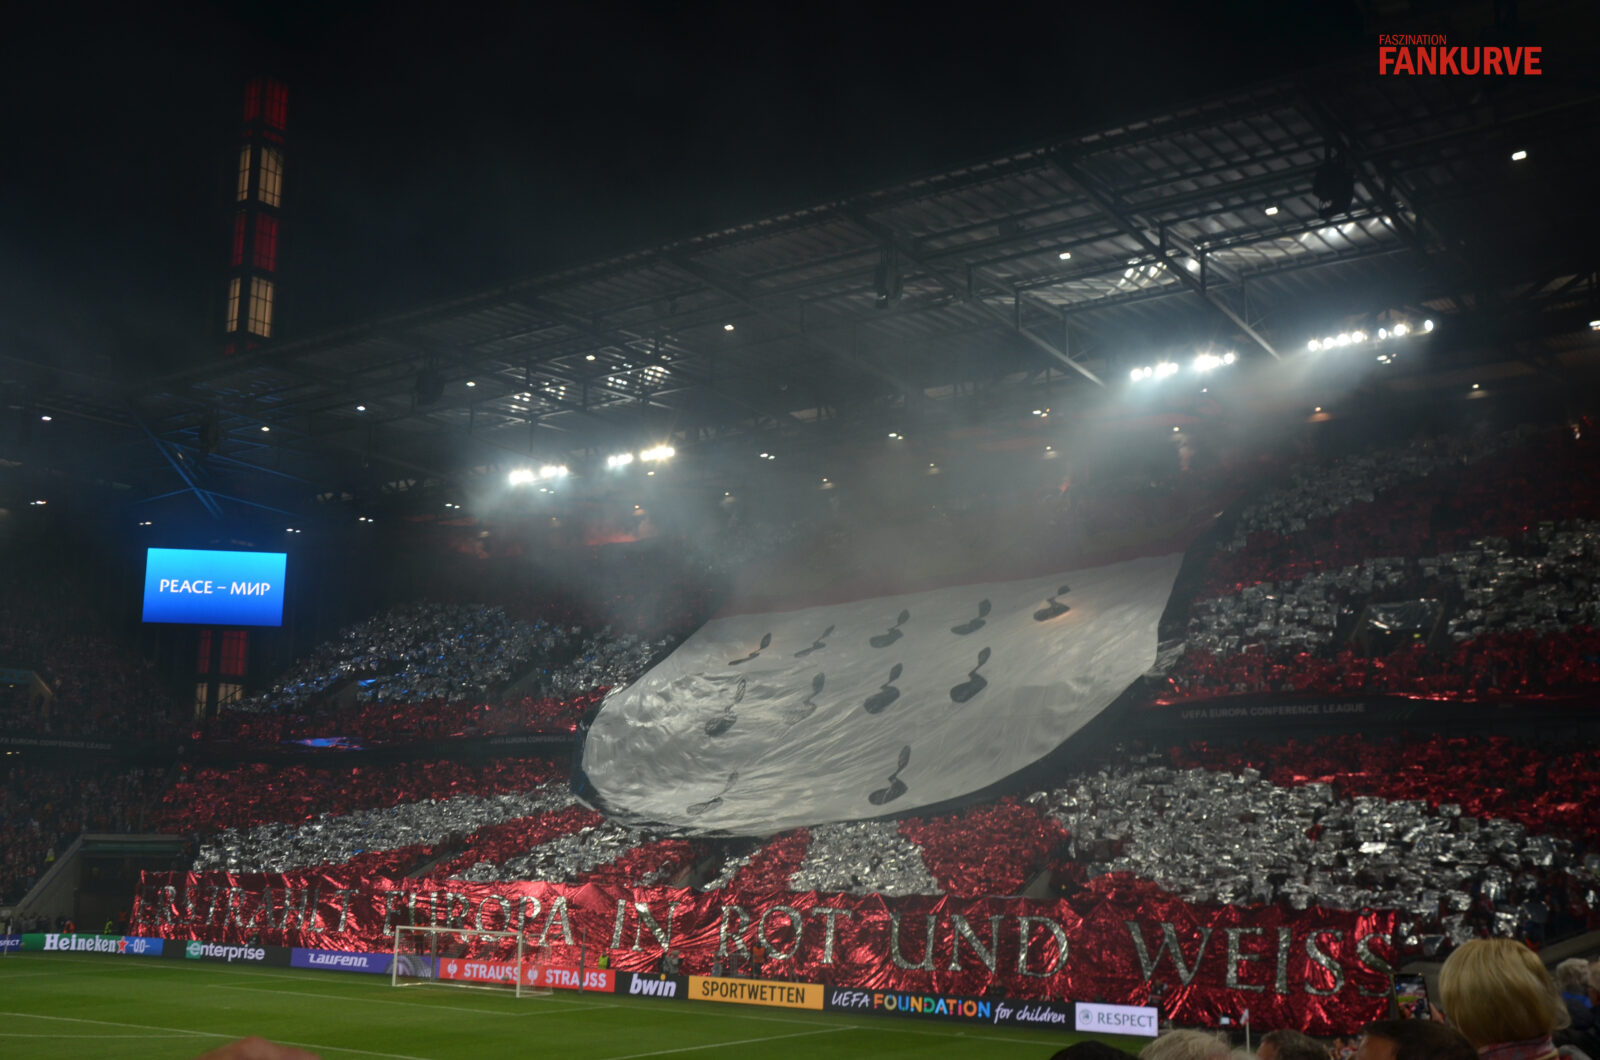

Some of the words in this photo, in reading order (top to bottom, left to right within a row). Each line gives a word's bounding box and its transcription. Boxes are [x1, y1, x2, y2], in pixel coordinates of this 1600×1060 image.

[159, 579, 213, 594] PEACE
[230, 582, 271, 596] МИР
[1182, 709, 1208, 720] UEFA
[1209, 707, 1248, 719] EUROPA
[1250, 704, 1319, 717] CONFERENCE
[1322, 703, 1365, 714] LEAGUE
[43, 933, 116, 953] Heineken
[190, 942, 265, 962] enterprise
[383, 891, 574, 946] EUROPA
[610, 899, 681, 953] IN
[719, 904, 852, 964] ROT
[888, 911, 1070, 978] UND
[1124, 920, 1393, 998] WEISS
[464, 963, 519, 984] STRAUSS
[545, 969, 607, 988] STRAUSS
[629, 973, 677, 997] bwin
[702, 980, 805, 1004] SPORTWETTEN
[831, 991, 871, 1008] UEFA
[873, 993, 992, 1019] FOUNDATION
[994, 1003, 1014, 1025] for
[1016, 1005, 1067, 1025] children
[1097, 1012, 1154, 1029] RESPECT
